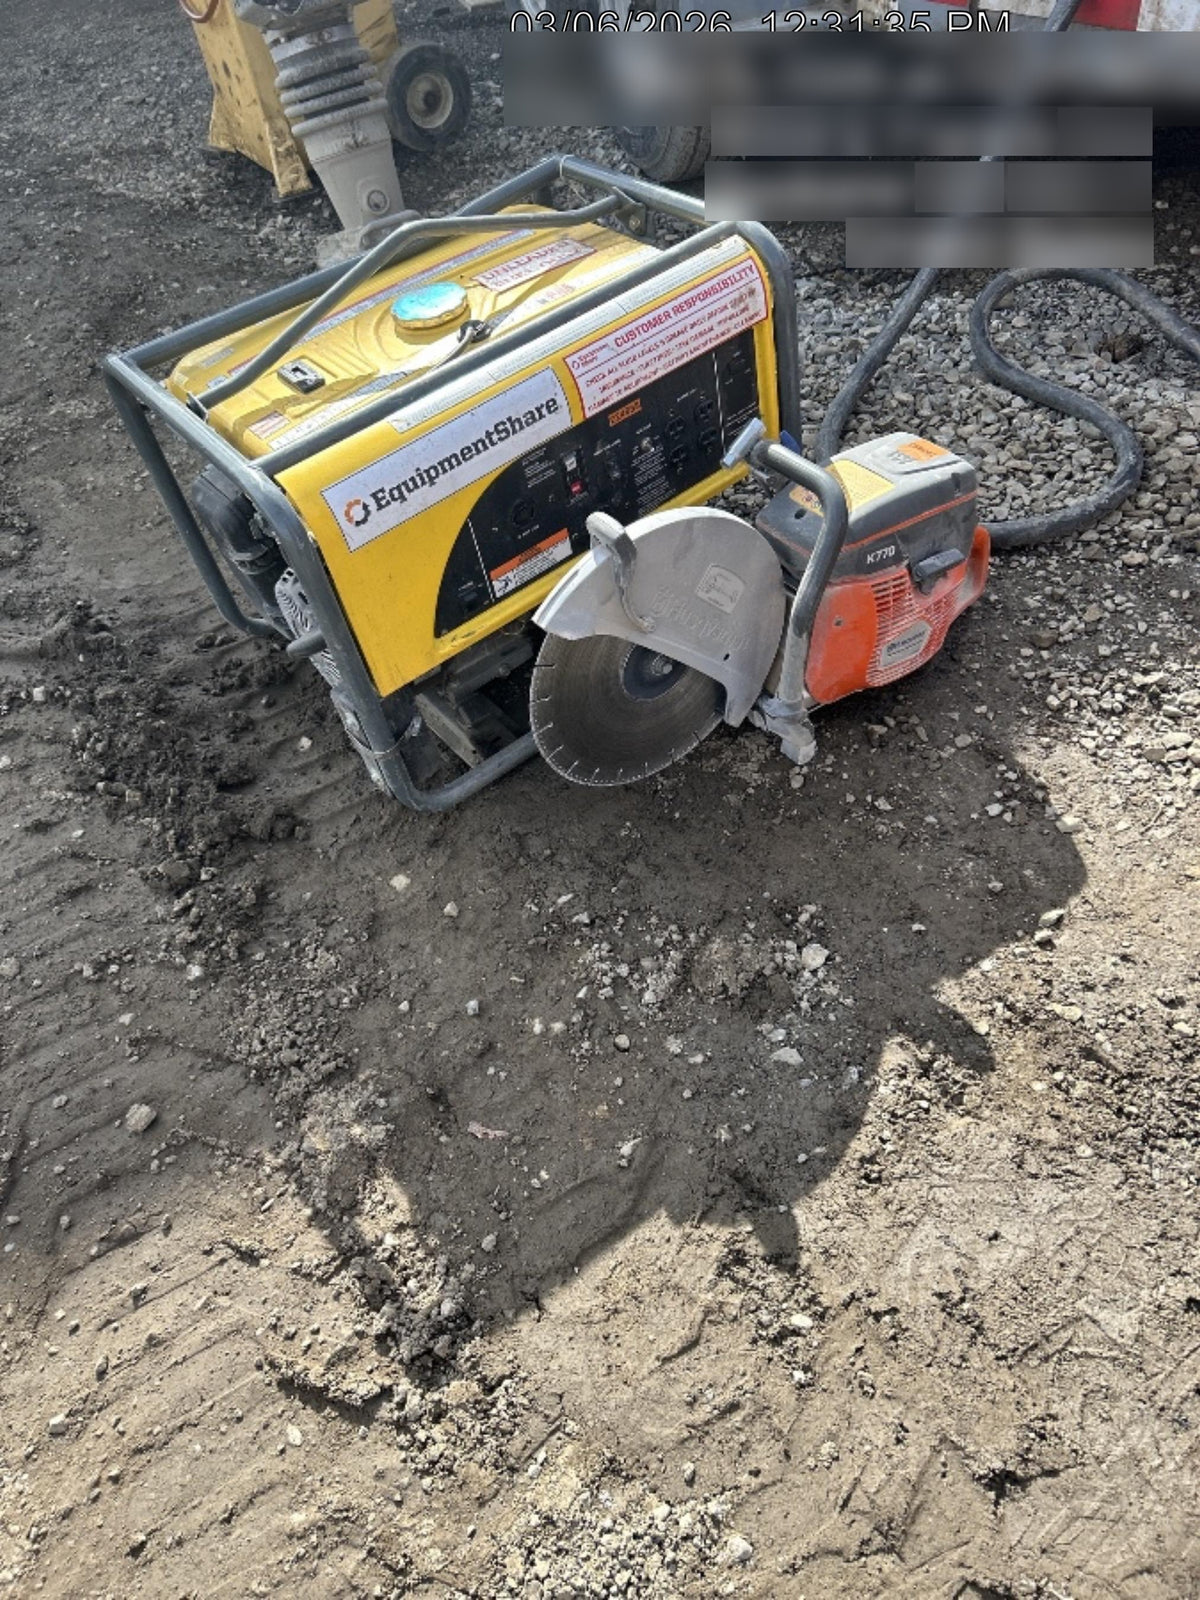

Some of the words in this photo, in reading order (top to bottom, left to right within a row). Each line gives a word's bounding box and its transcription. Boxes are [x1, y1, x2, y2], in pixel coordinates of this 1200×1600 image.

[614, 310, 672, 348] CUSTOMER
[671, 264, 756, 317] RESPONSIBILITY
[369, 396, 560, 514] EquipmentShare
[866, 545, 896, 565] K770
